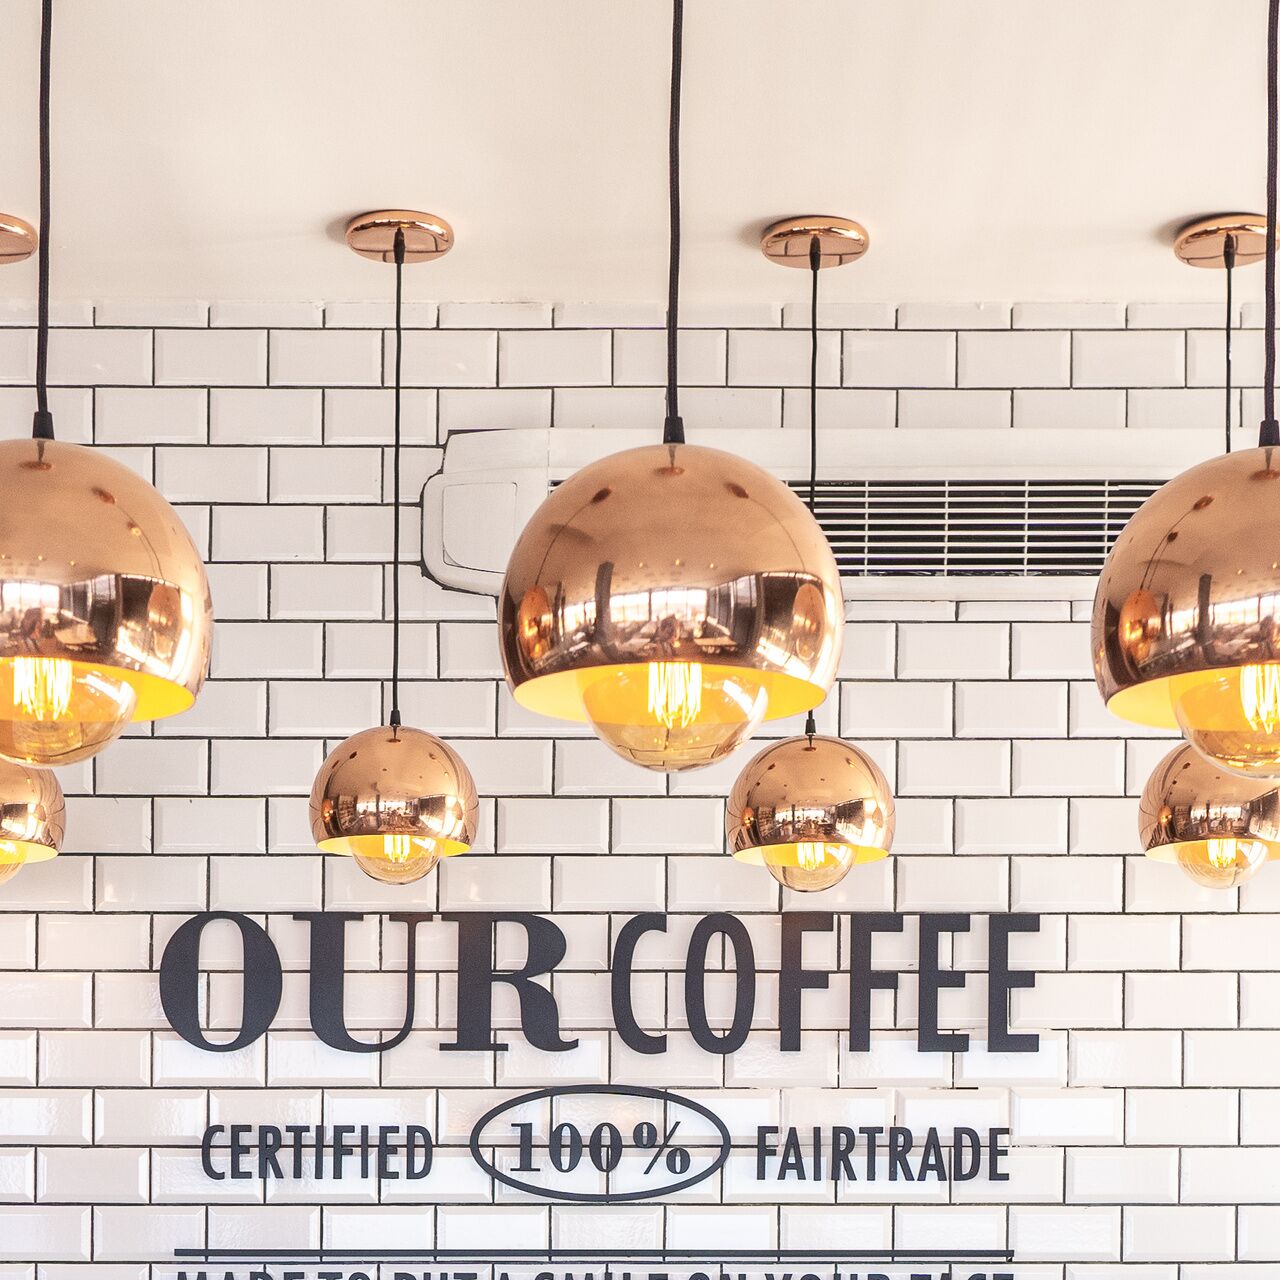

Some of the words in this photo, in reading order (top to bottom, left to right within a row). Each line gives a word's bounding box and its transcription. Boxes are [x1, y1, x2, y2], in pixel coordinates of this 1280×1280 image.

[158, 910, 579, 1053] OUR
[611, 911, 1041, 1054] COFFEE
[201, 1124, 433, 1181] CERTIFIED
[507, 1119, 692, 1176] 100%
[756, 1125, 1010, 1182] FAIRTRADE
